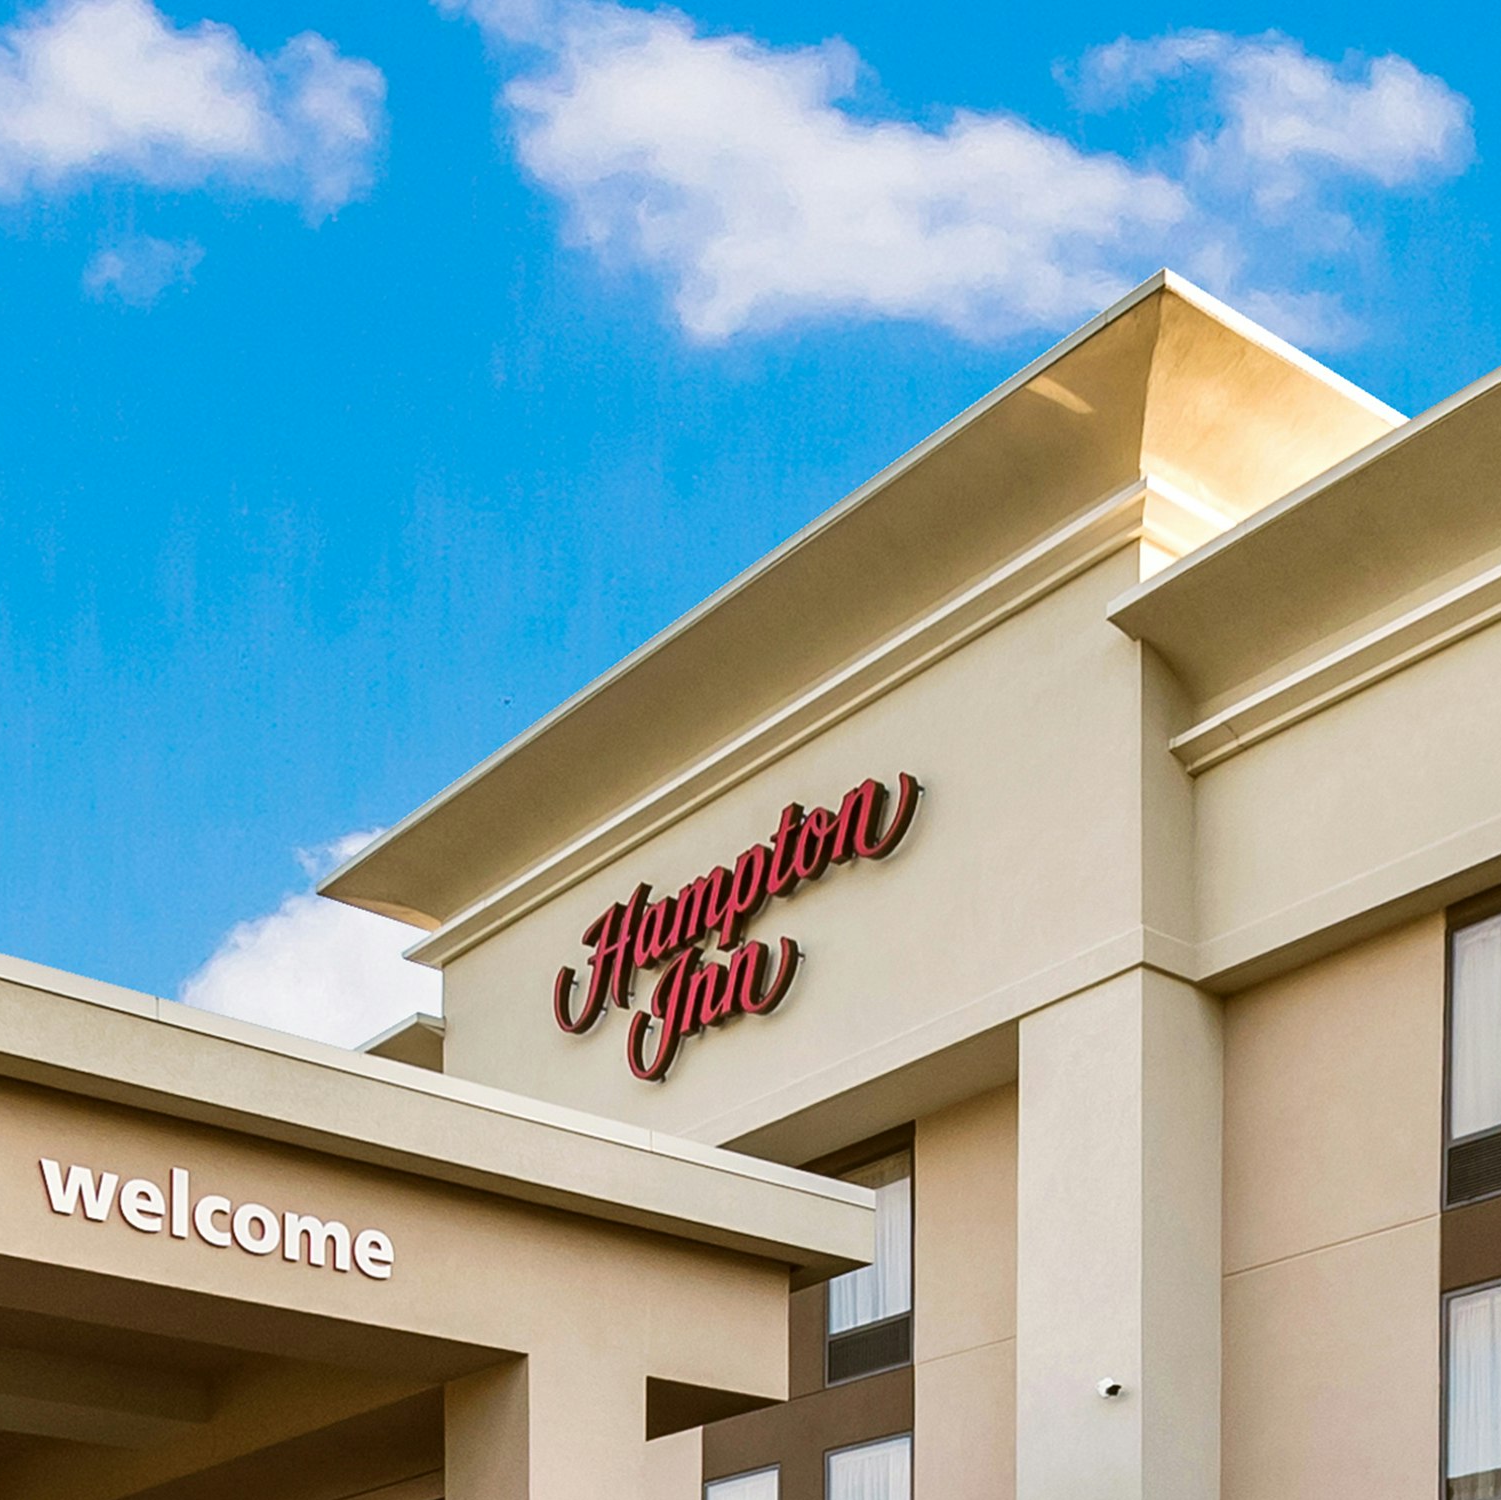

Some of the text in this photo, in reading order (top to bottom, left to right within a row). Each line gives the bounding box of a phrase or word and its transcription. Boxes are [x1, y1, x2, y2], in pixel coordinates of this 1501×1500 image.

[553, 771, 920, 1034] Hampton
[626, 936, 800, 1082] Inn
[39, 1157, 395, 1280] welcome
